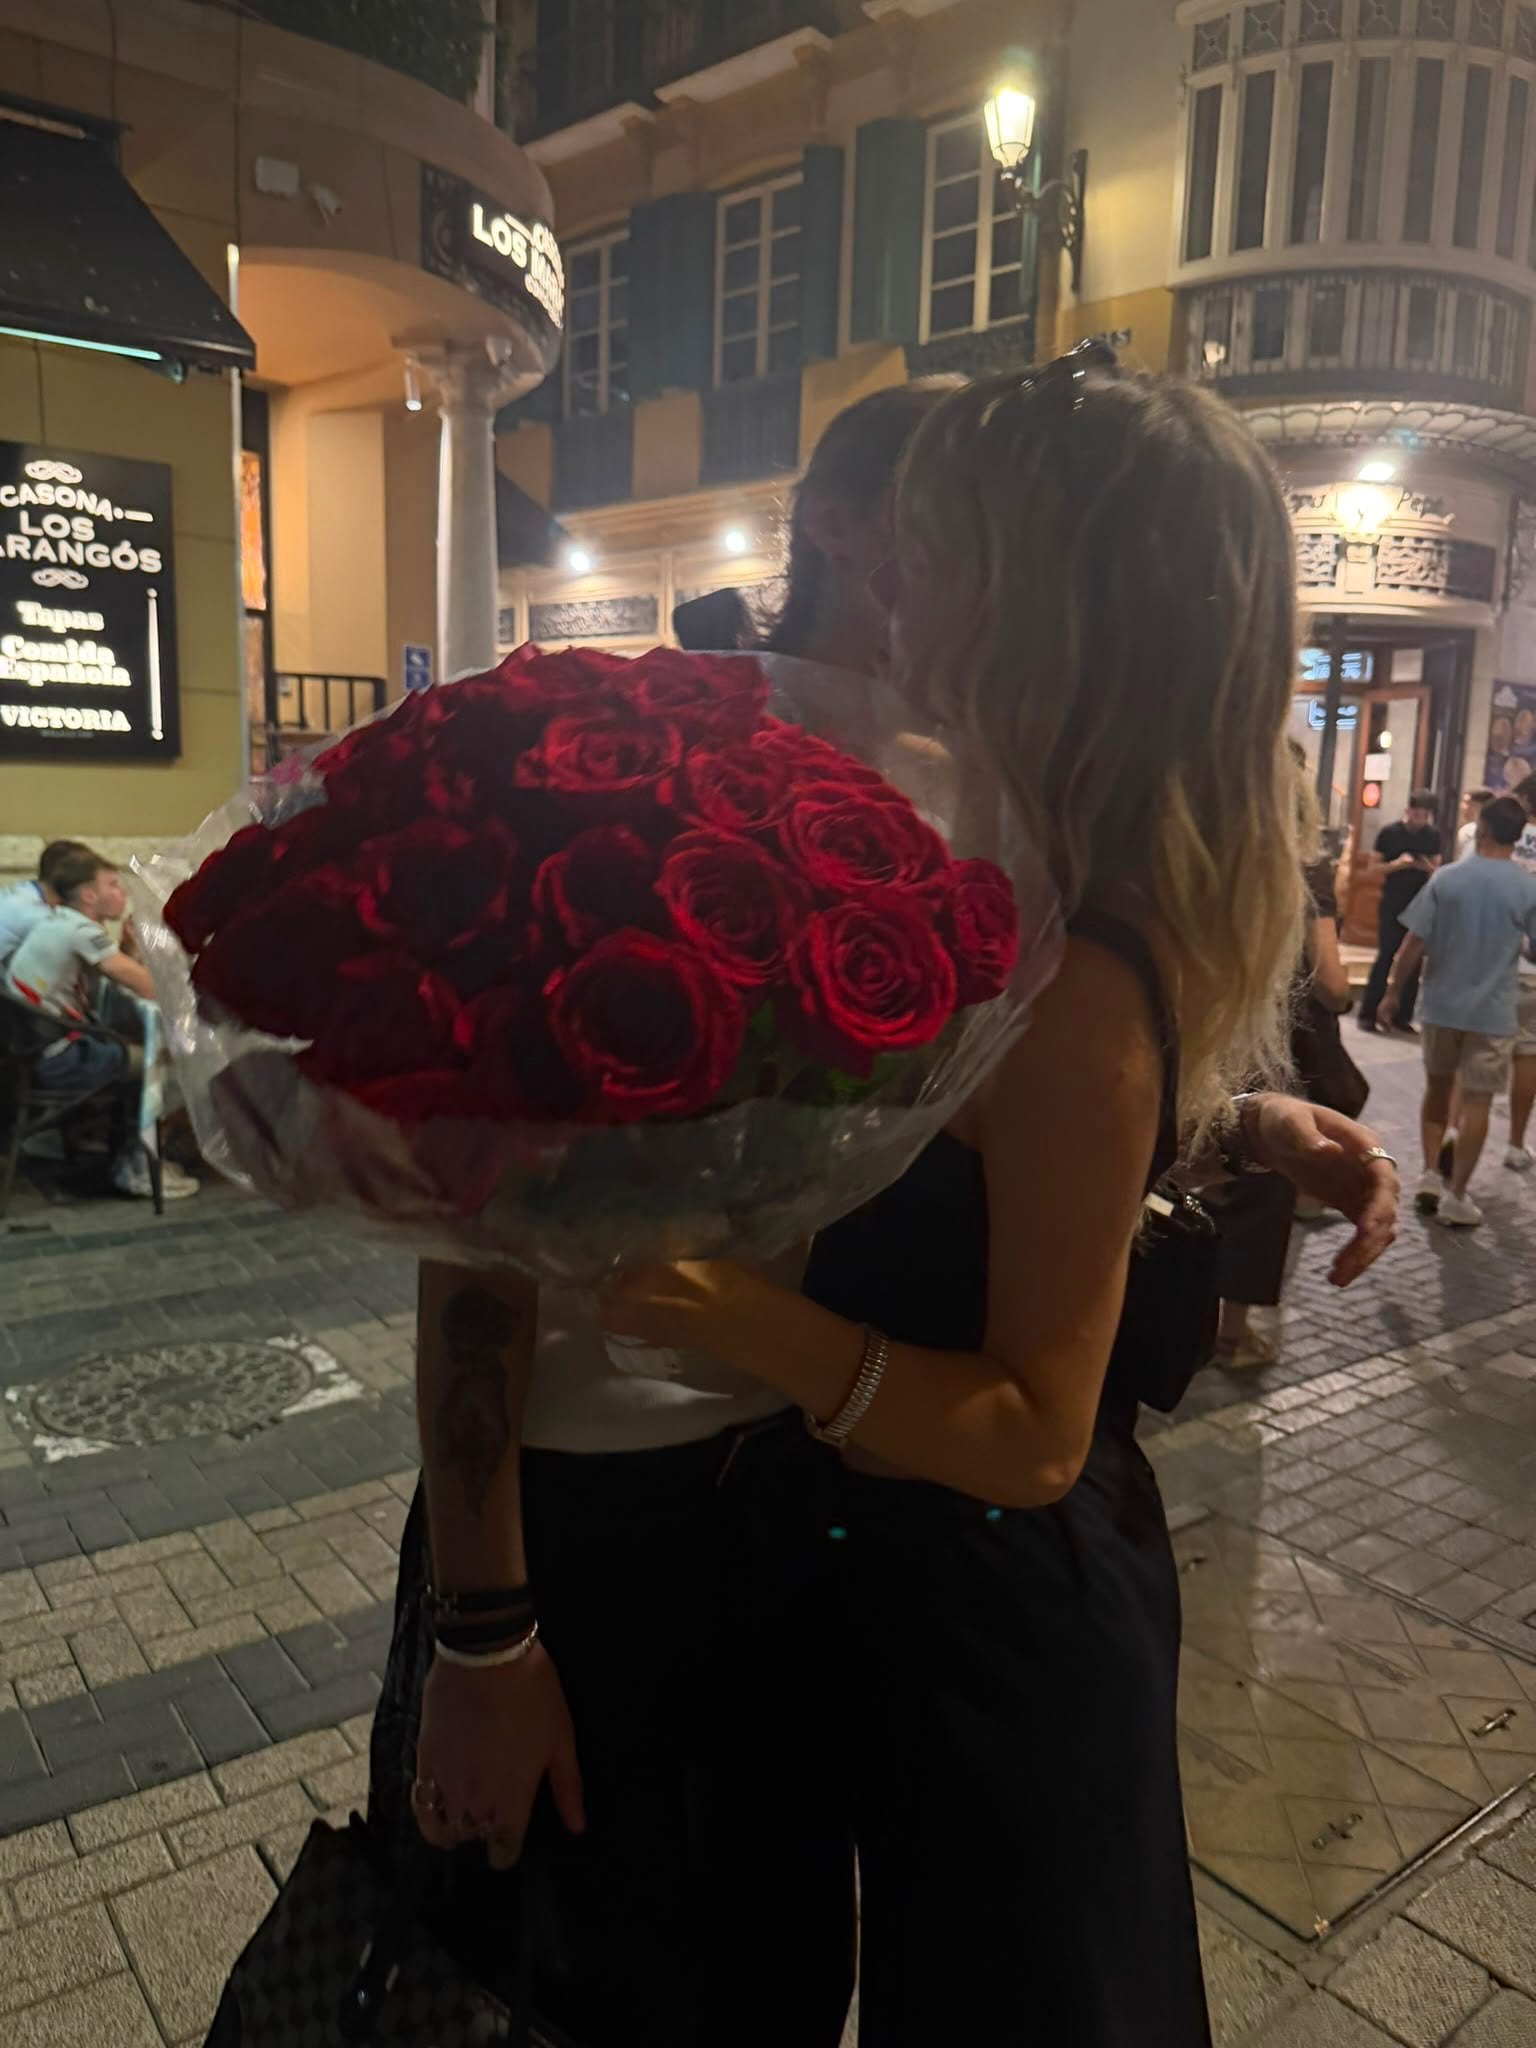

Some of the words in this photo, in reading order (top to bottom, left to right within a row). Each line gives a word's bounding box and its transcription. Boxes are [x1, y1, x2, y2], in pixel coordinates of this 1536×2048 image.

[472, 202, 528, 269] LOS
[19, 510, 96, 542] LOS
[0, 634, 116, 667] Comida
[0, 704, 132, 732] VICTORIA
